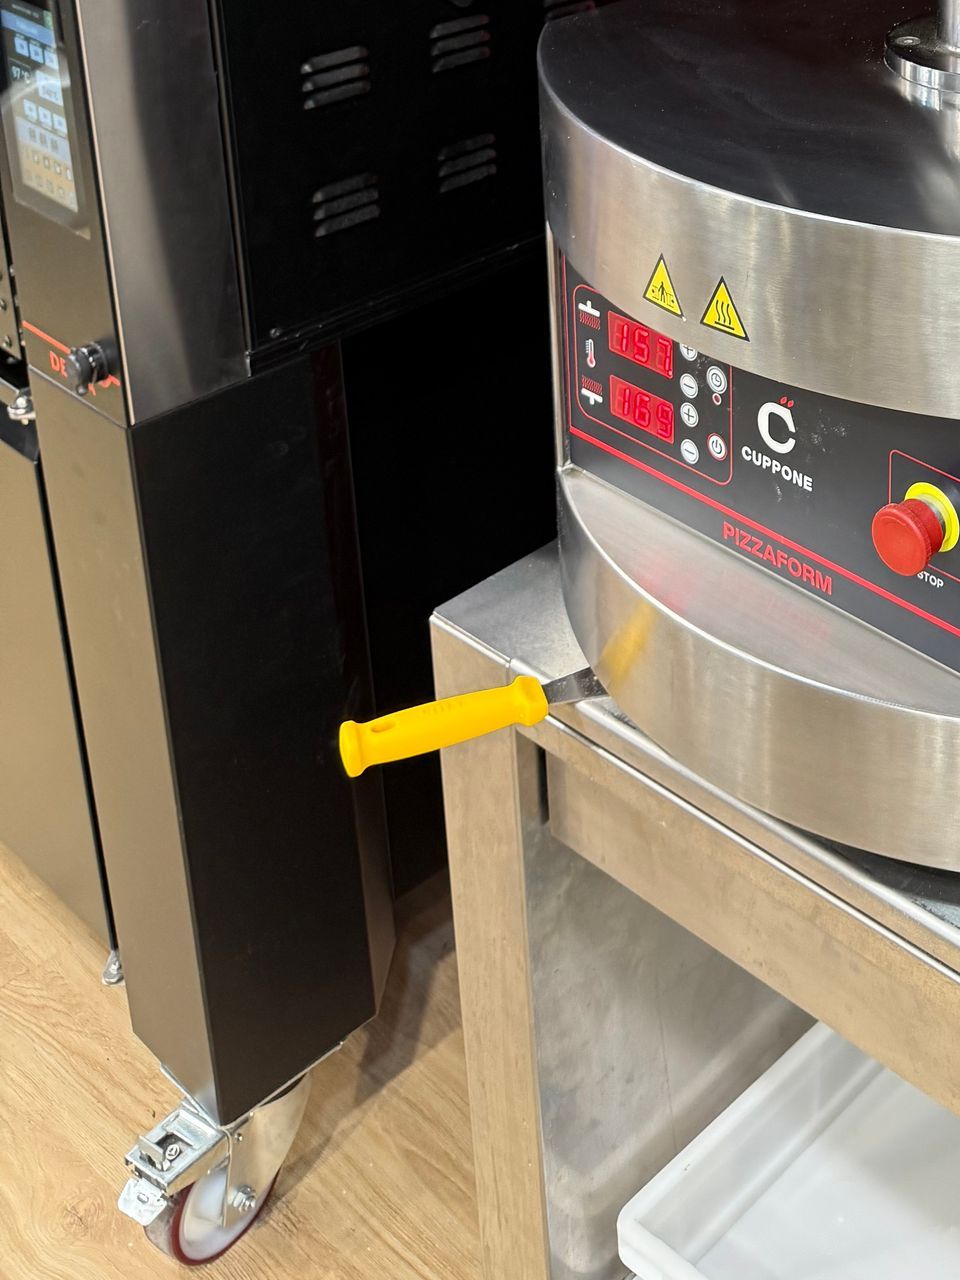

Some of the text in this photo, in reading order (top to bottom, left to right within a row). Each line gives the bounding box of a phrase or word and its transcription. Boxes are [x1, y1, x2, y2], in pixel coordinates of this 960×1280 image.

[623, 388, 673, 438] 169
[741, 445, 813, 492] CUPPONE
[722, 521, 833, 596] PIZZAFORM
[917, 570, 944, 588] STOP
